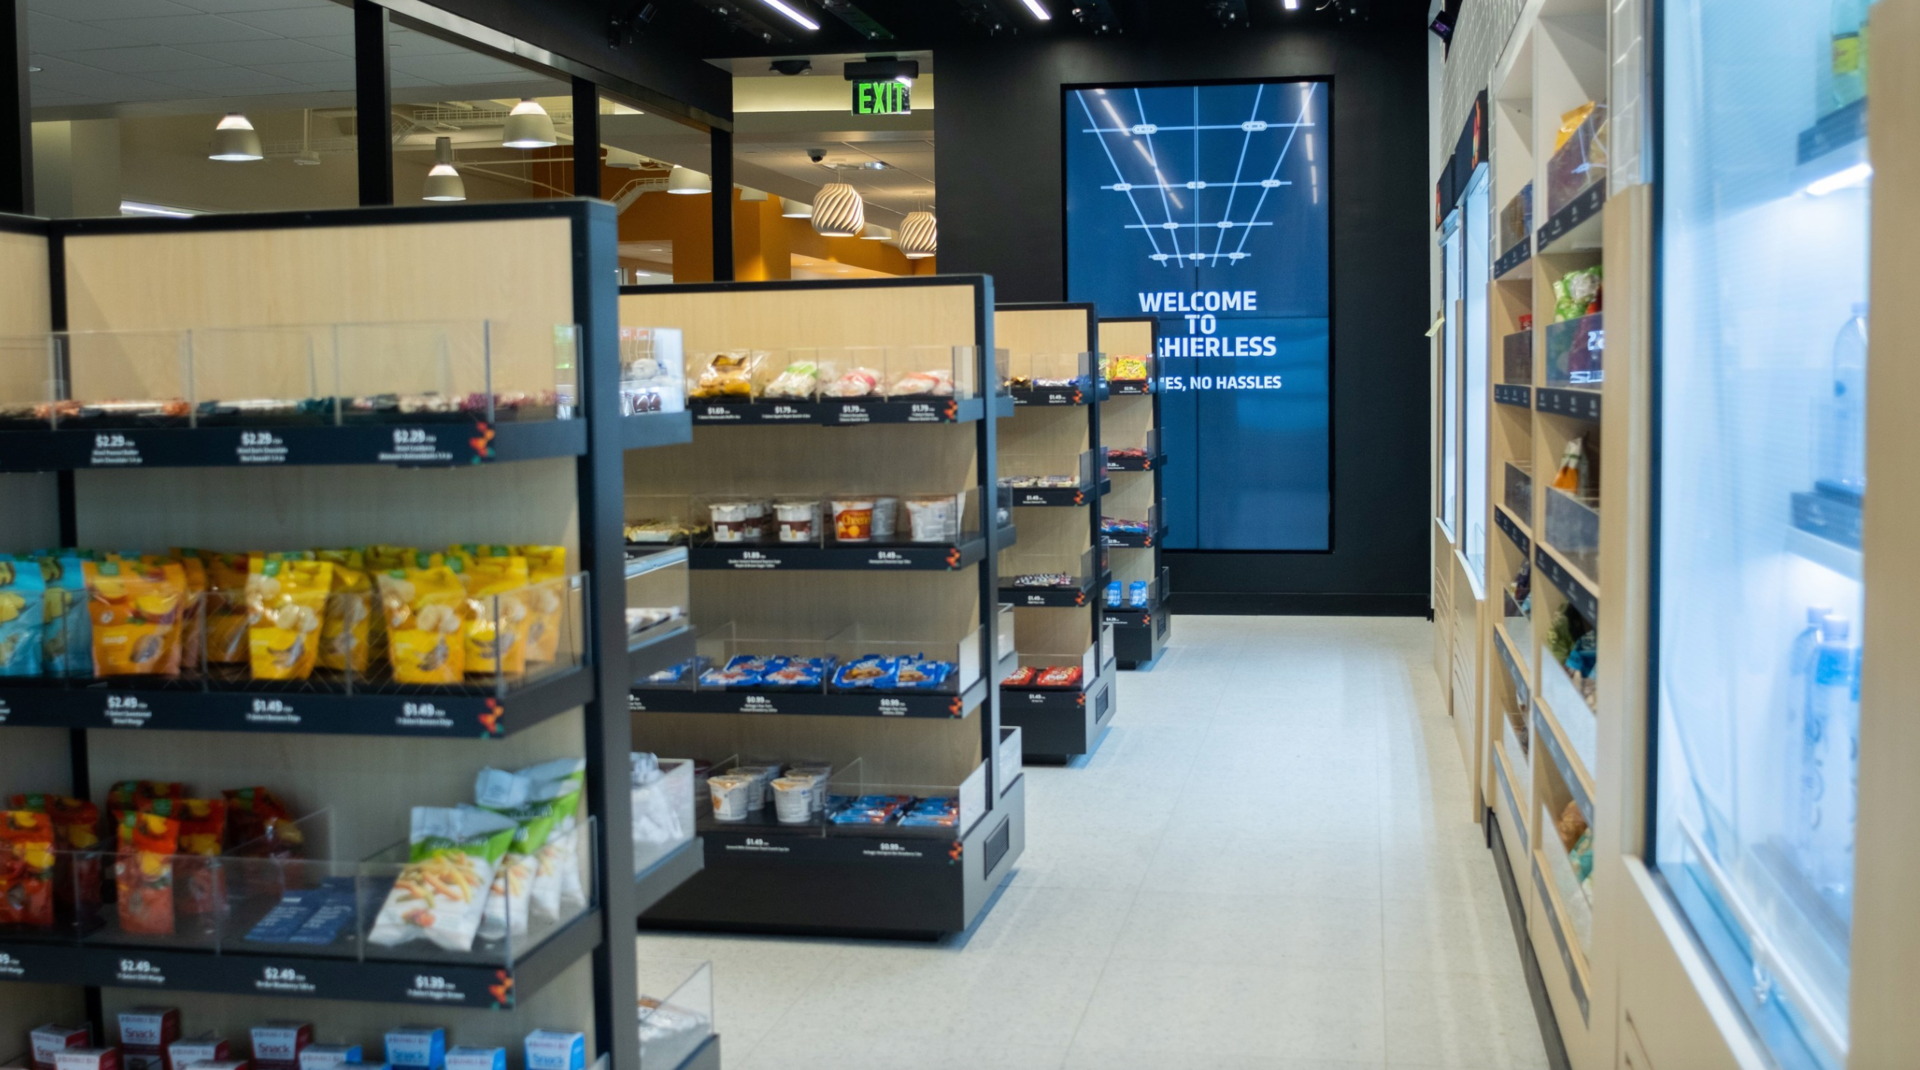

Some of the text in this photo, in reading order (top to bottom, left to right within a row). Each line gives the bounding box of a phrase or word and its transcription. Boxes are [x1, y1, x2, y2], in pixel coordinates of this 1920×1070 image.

[859, 82, 905, 114] EXIT
[1138, 290, 1257, 313] WELCOME
[1184, 313, 1217, 335] TO
[1190, 376, 1212, 390] NO
[1216, 375, 1282, 390] HASSLES
[774, 405, 792, 414] $1.79
[842, 404, 860, 413] $1.79
[911, 404, 929, 413] $1.79
[95, 434, 125, 448] $2.29
[241, 431, 272, 446] $2.29
[393, 428, 426, 444] $2.29
[877, 551, 896, 560] $1.49
[107, 696, 138, 709] $2.49
[253, 698, 283, 713] $1.49
[746, 695, 765, 704] $0.99
[880, 698, 900, 707] $0.99
[403, 702, 435, 717] $1.49
[746, 837, 764, 846] $1.49
[880, 842, 900, 851] $0.99
[121, 959, 150, 972] $2.49
[264, 966, 296, 981] $2.49
[125, 1027, 156, 1039] Snack
[258, 1042, 290, 1053] Snack
